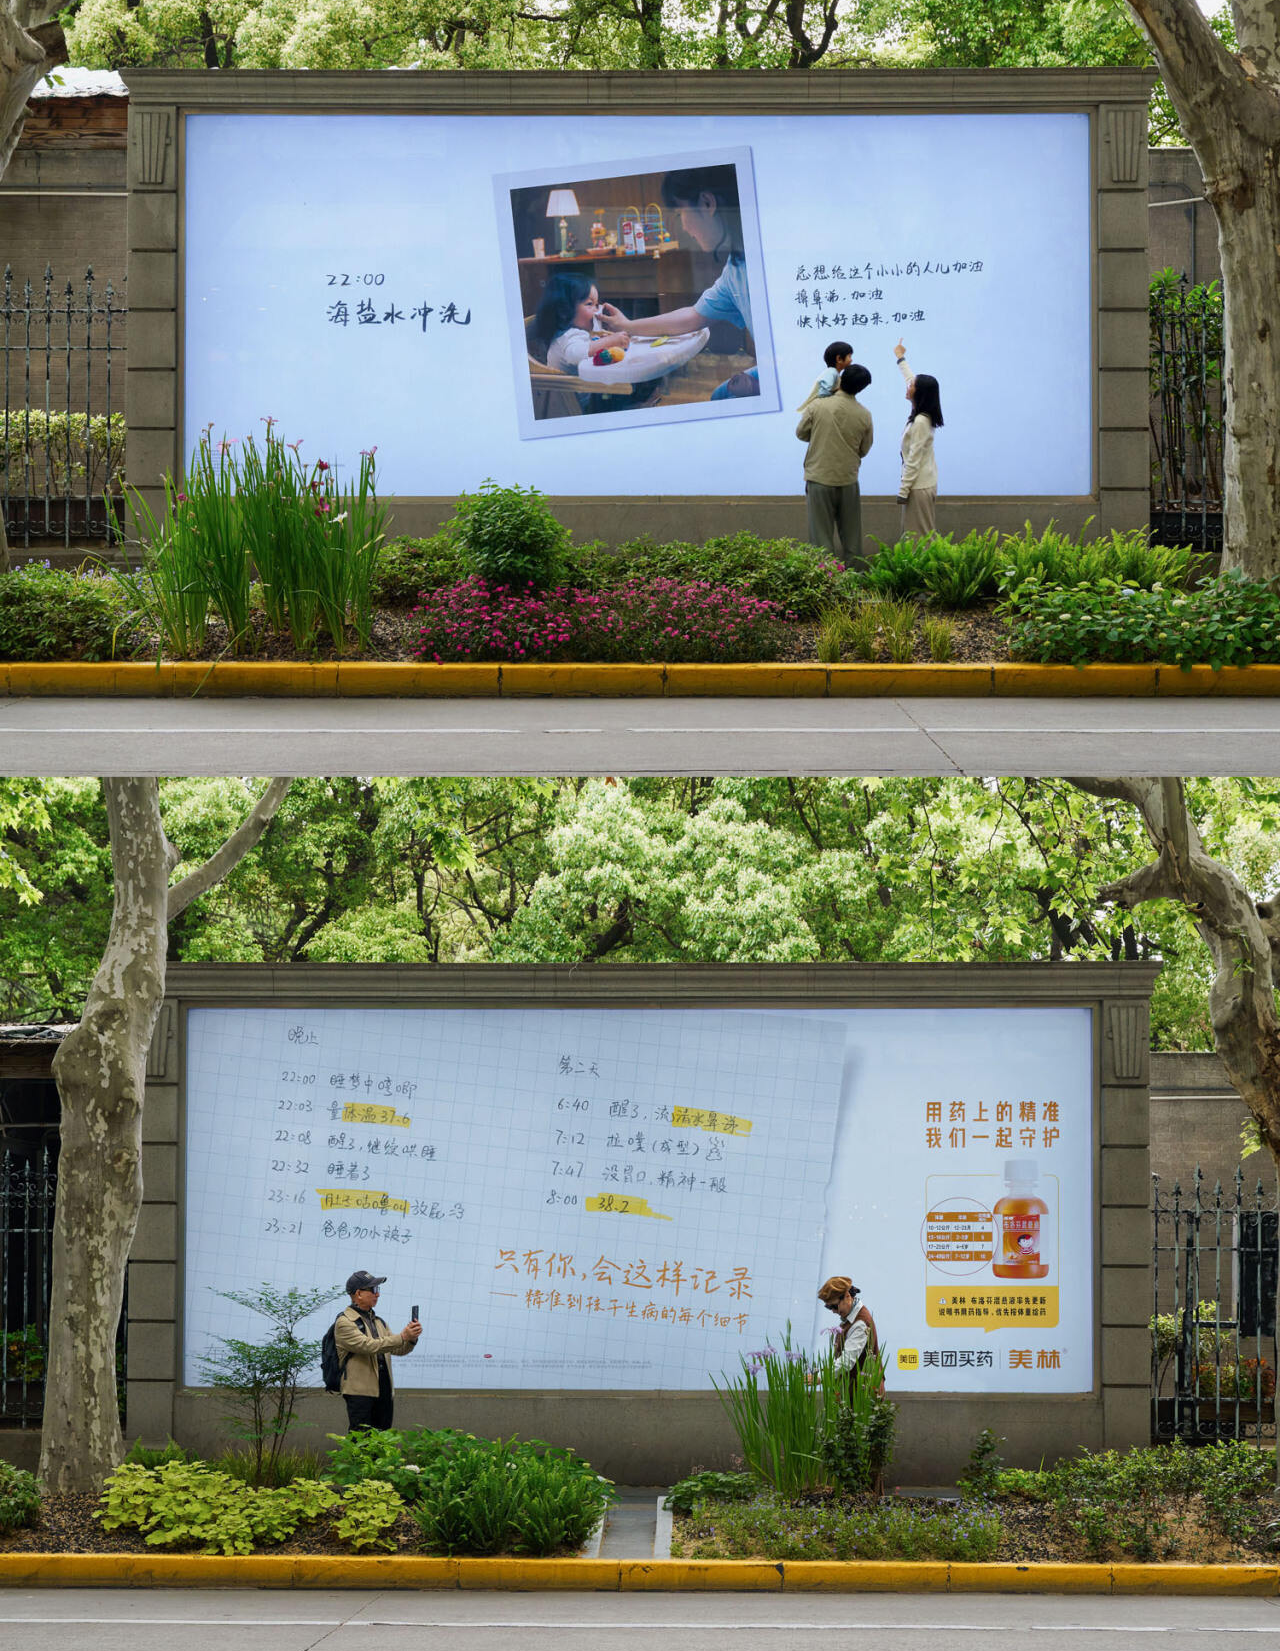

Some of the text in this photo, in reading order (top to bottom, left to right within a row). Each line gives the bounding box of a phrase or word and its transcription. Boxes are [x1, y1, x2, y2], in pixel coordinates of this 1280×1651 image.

[326, 273, 385, 286] 22:00
[326, 297, 471, 333] 海盐水冲洗
[287, 1025, 319, 1045] 晚上
[559, 1055, 600, 1079] 第二天
[281, 1070, 316, 1085] 22:00
[278, 1100, 313, 1113] 22:03
[557, 1098, 590, 1112] 6:40
[926, 1100, 1060, 1123] 用药上的精准
[275, 1130, 312, 1146] 22:08
[555, 1129, 585, 1146] 7:12
[926, 1126, 1060, 1149] 我们一起守护
[271, 1160, 370, 1181] 22:32 睡着了
[552, 1160, 584, 1178] 7:47
[268, 1189, 306, 1204] 23:16
[546, 1189, 630, 1213] 8:00 38.2
[264, 1218, 413, 1244] 23:21 爸爸加小被子
[494, 1249, 755, 1301] 只有你，会这样记录
[922, 1349, 1062, 1369] 美团买药 美林
